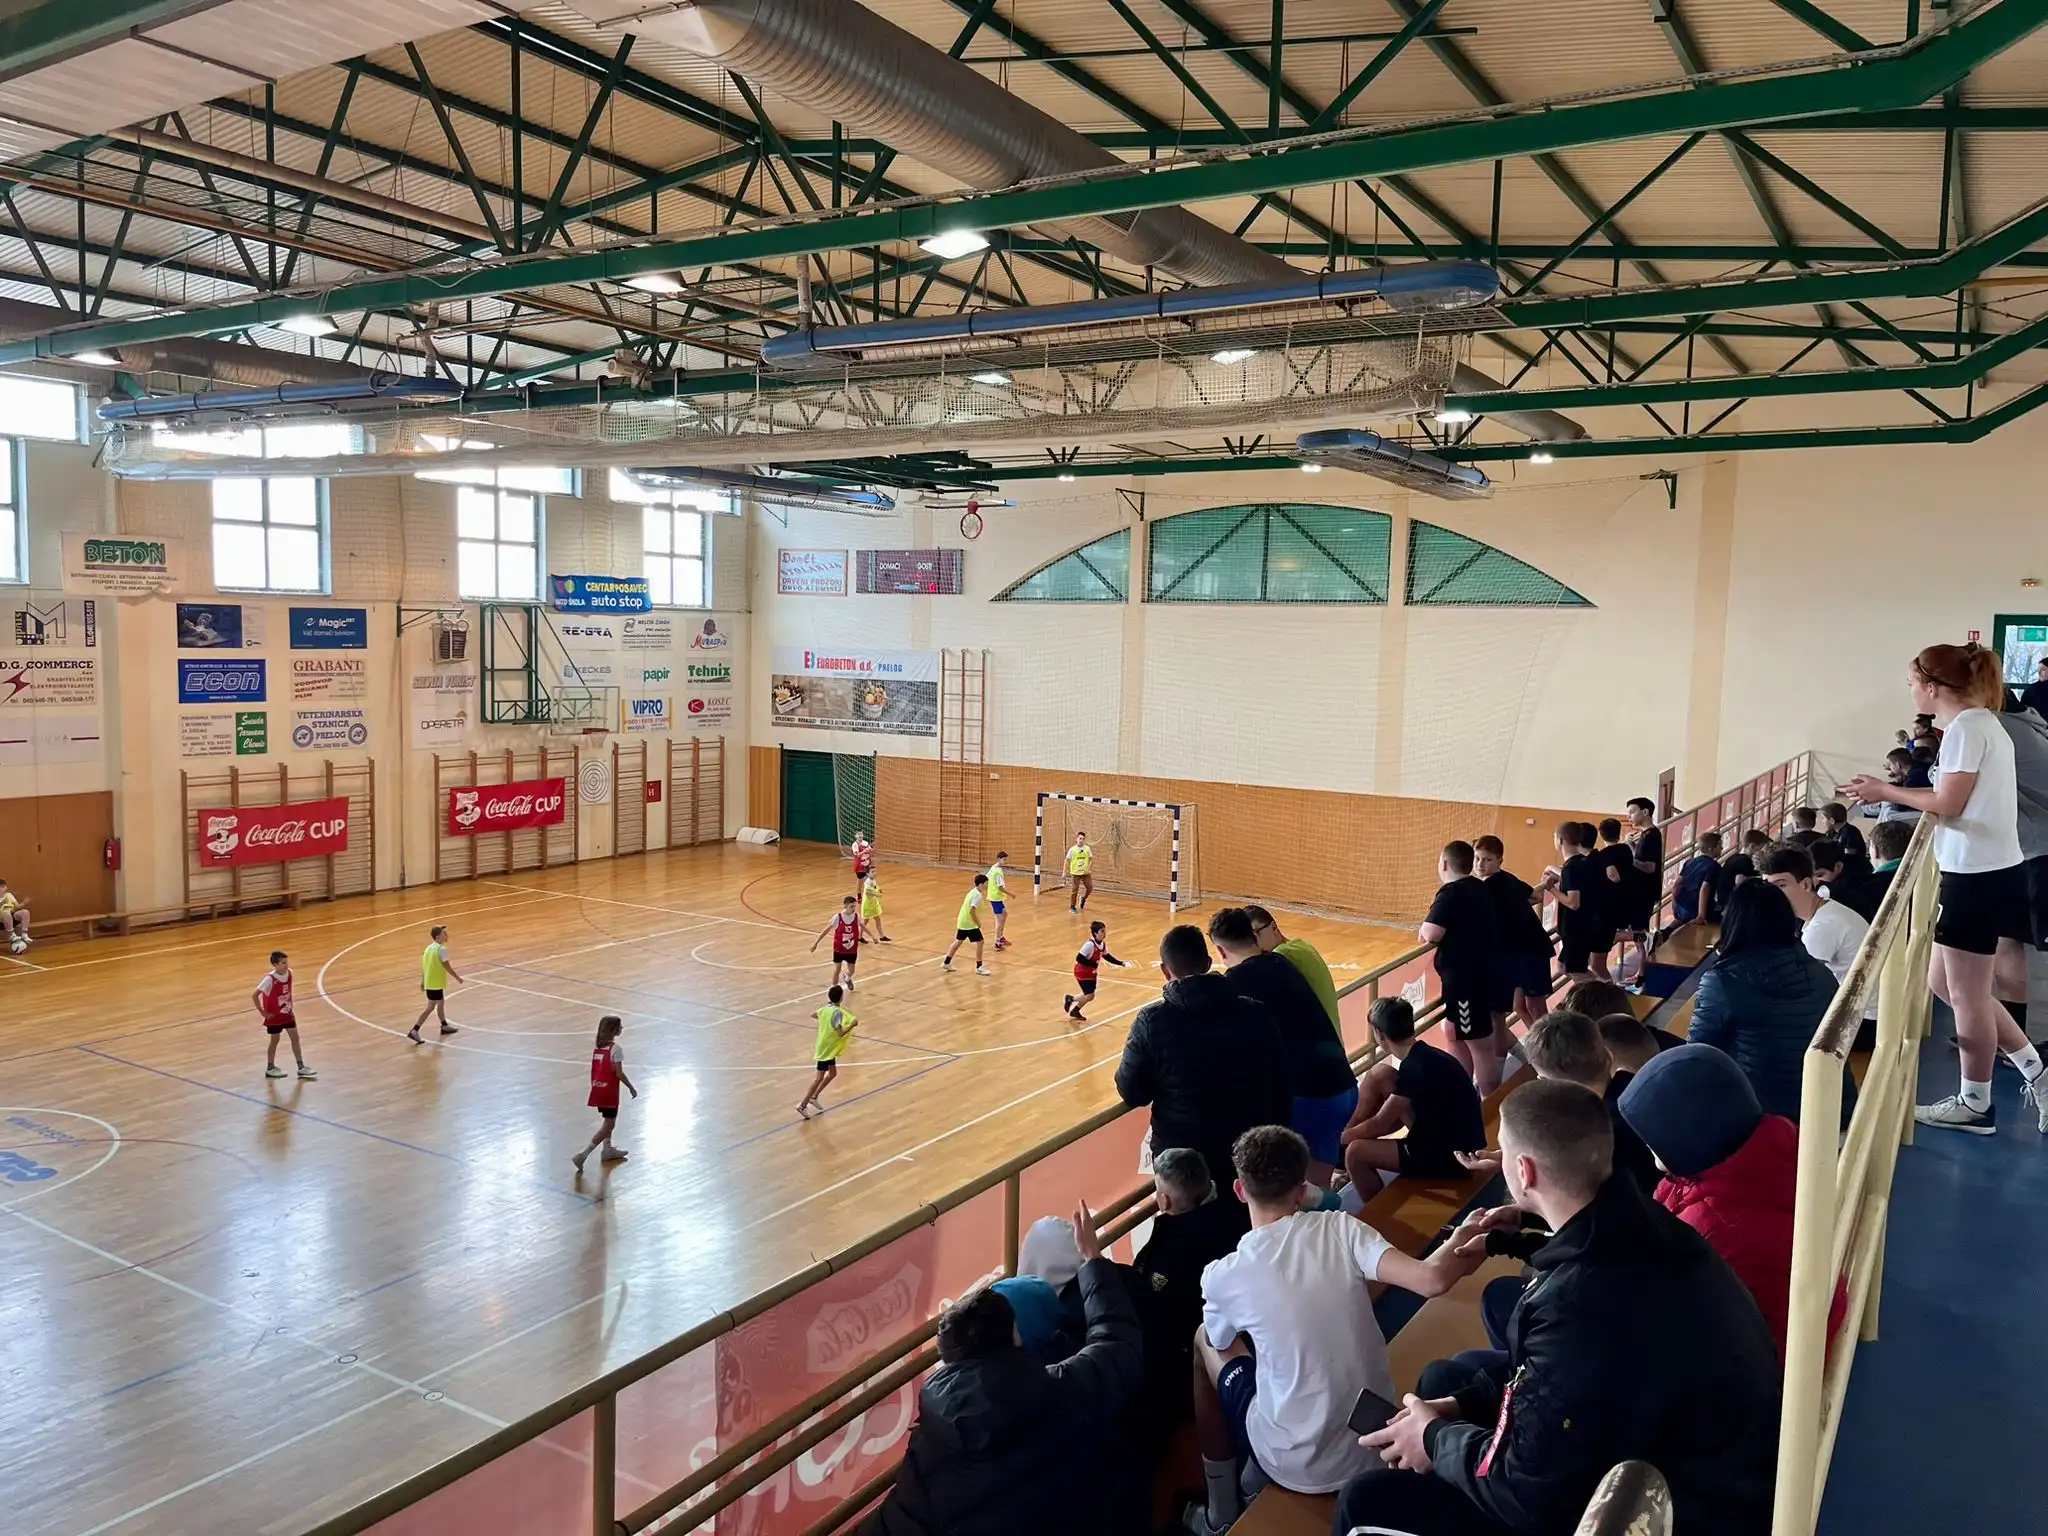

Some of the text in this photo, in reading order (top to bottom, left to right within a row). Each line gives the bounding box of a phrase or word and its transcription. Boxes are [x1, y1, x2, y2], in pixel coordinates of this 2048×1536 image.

[84, 540, 166, 565] BETON
[591, 595, 643, 609] auto stop
[26, 661, 93, 670] COMMERCE
[293, 660, 361, 671] GRABANT
[688, 662, 731, 677] Tehnix
[644, 667, 670, 682] papir
[632, 699, 663, 714] VIPRO
[297, 710, 363, 719] VETERINARSKA
[312, 720, 349, 729] STANICA
[421, 719, 464, 729] OPERETA
[535, 795, 561, 813] CUP
[309, 819, 345, 839] CUP
